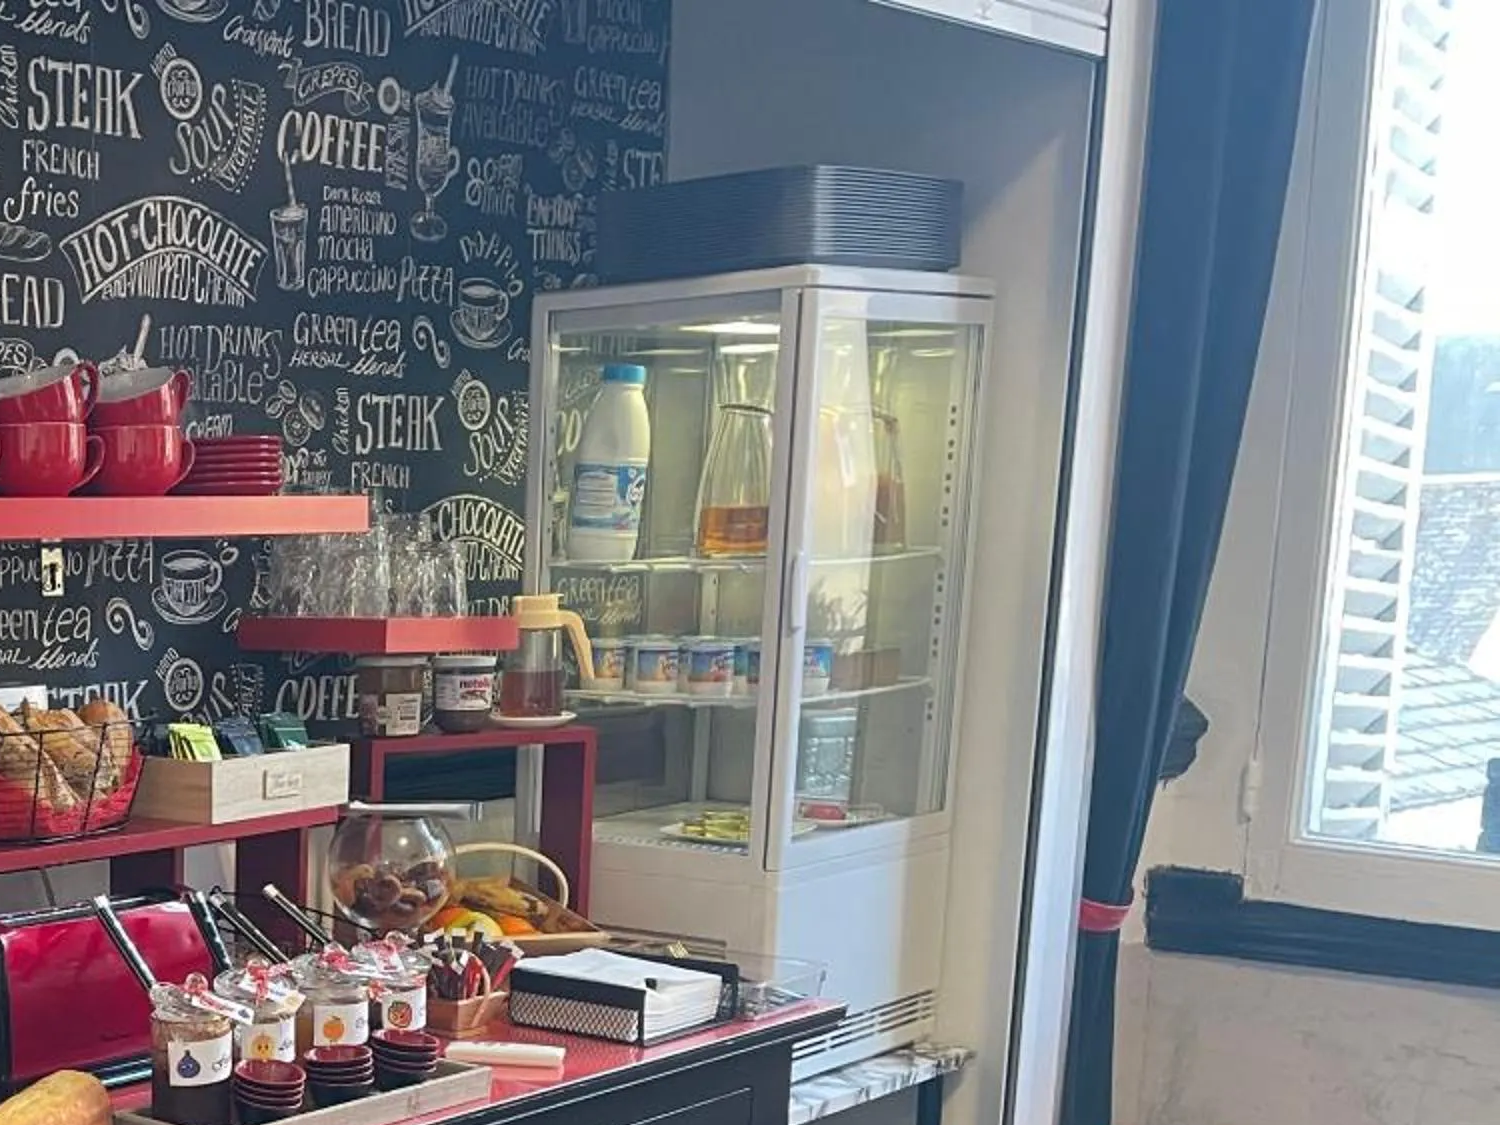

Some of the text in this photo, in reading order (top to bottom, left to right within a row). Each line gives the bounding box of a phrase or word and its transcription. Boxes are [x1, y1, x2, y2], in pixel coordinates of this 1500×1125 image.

[223, 15, 296, 58] Croissant
[303, 0, 390, 57] BREAD
[27, 55, 145, 140] STEAK
[169, 83, 235, 175] SOUP
[277, 109, 387, 174] COFFEE
[22, 138, 101, 181] FRENCH
[3, 176, 80, 224] fries
[70, 201, 262, 293] HOT CHOCOLATE
[159, 323, 283, 380] HOT DRINKS
[359, 314, 401, 356] tea
[355, 392, 445, 456] STEAK
[463, 397, 514, 477] SOUP
[351, 461, 411, 490] FRENCH
[41, 602, 93, 648] tea
